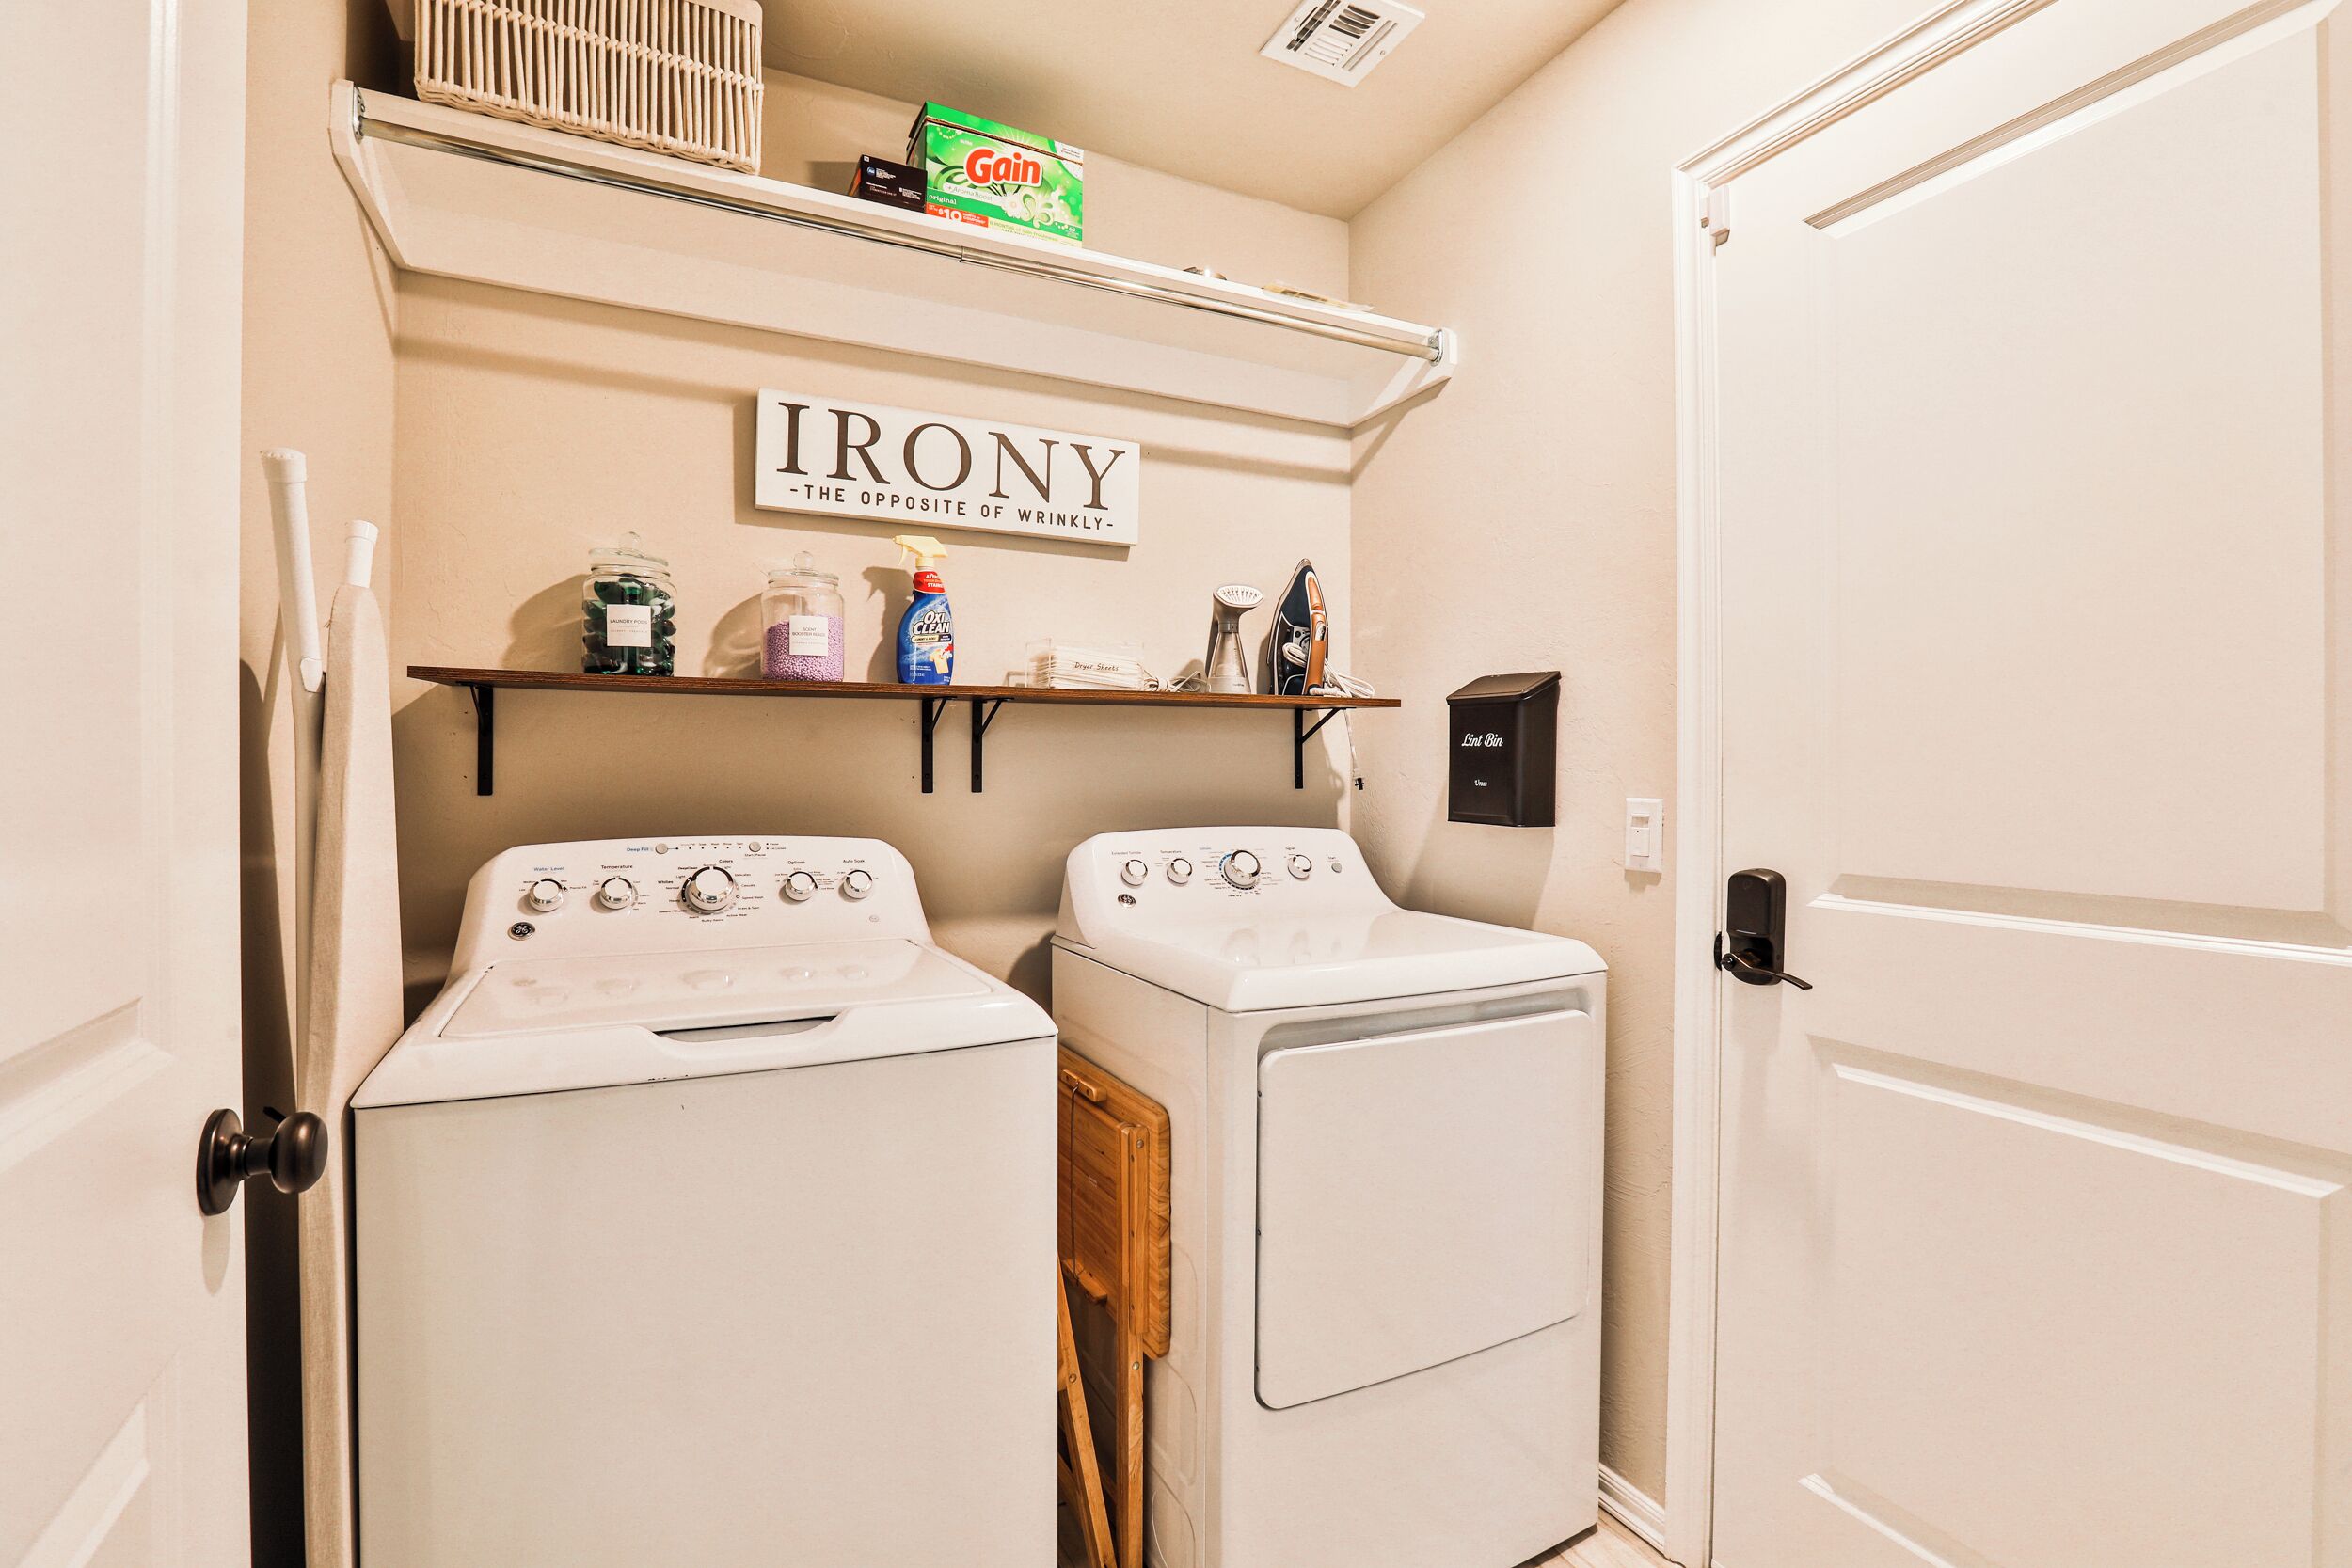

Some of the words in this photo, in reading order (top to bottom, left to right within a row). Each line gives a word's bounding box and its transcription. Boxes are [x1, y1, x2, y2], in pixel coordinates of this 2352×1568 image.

[966, 149, 1041, 184] Gain
[929, 195, 957, 205] original
[776, 402, 1126, 511] IRONY
[861, 491, 966, 515] OPPOSITE
[980, 504, 1004, 519] OF
[924, 610, 946, 623] OXI
[913, 621, 950, 635] CLEAN
[1074, 661, 1093, 671] Dryer
[1096, 662, 1120, 672] Sheets
[1461, 733, 1483, 747] Lint
[1484, 733, 1503, 748] Bin
